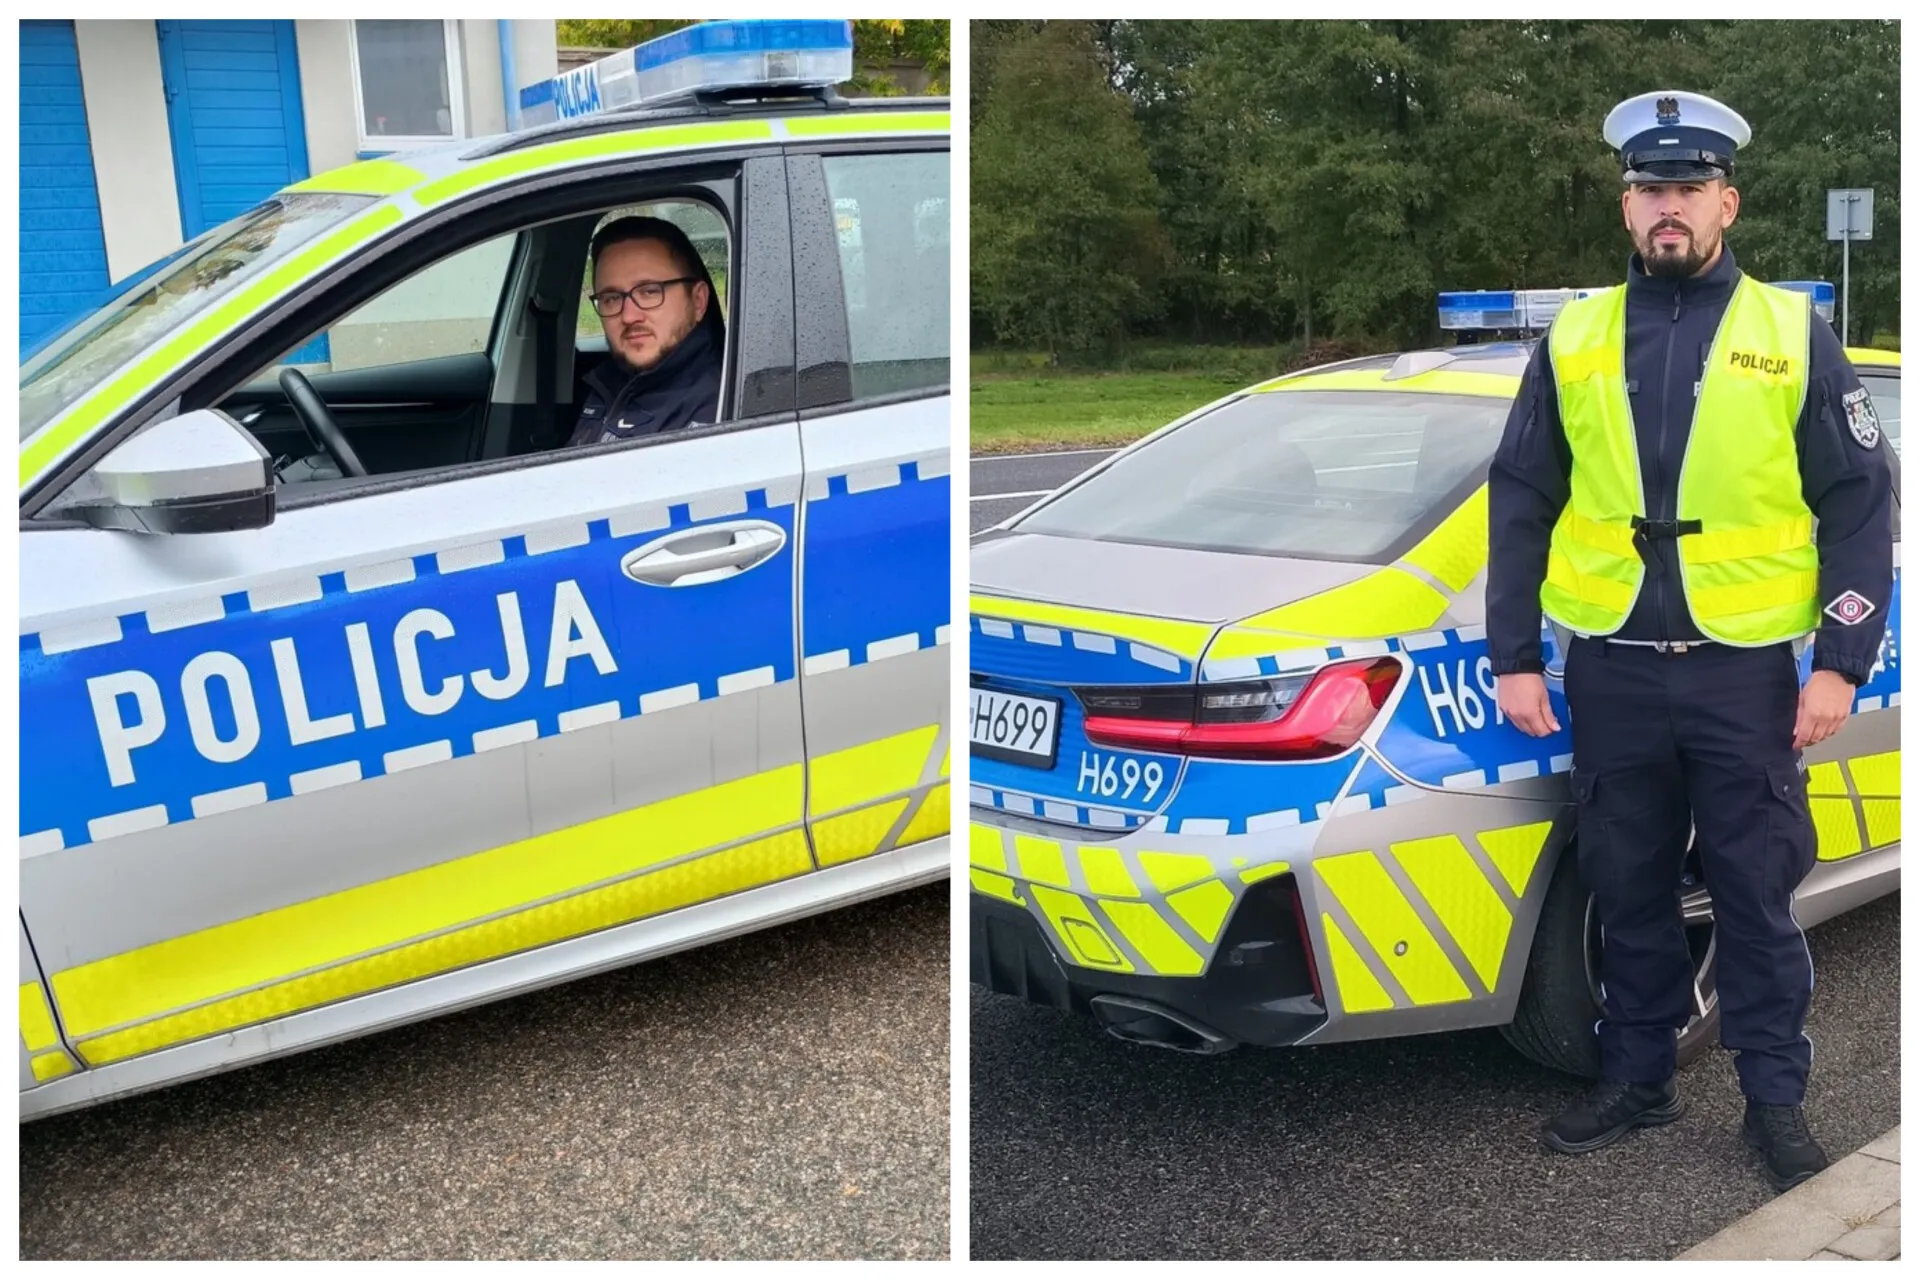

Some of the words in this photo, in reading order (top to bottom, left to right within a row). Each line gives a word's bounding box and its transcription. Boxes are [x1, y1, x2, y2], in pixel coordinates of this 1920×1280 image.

[553, 66, 601, 121] POLICJA
[1730, 351, 1790, 376] POLICJA
[86, 579, 619, 788] POLICJA
[1418, 656, 1503, 738] H69
[973, 693, 1048, 750] H699
[1077, 751, 1164, 803] H699
